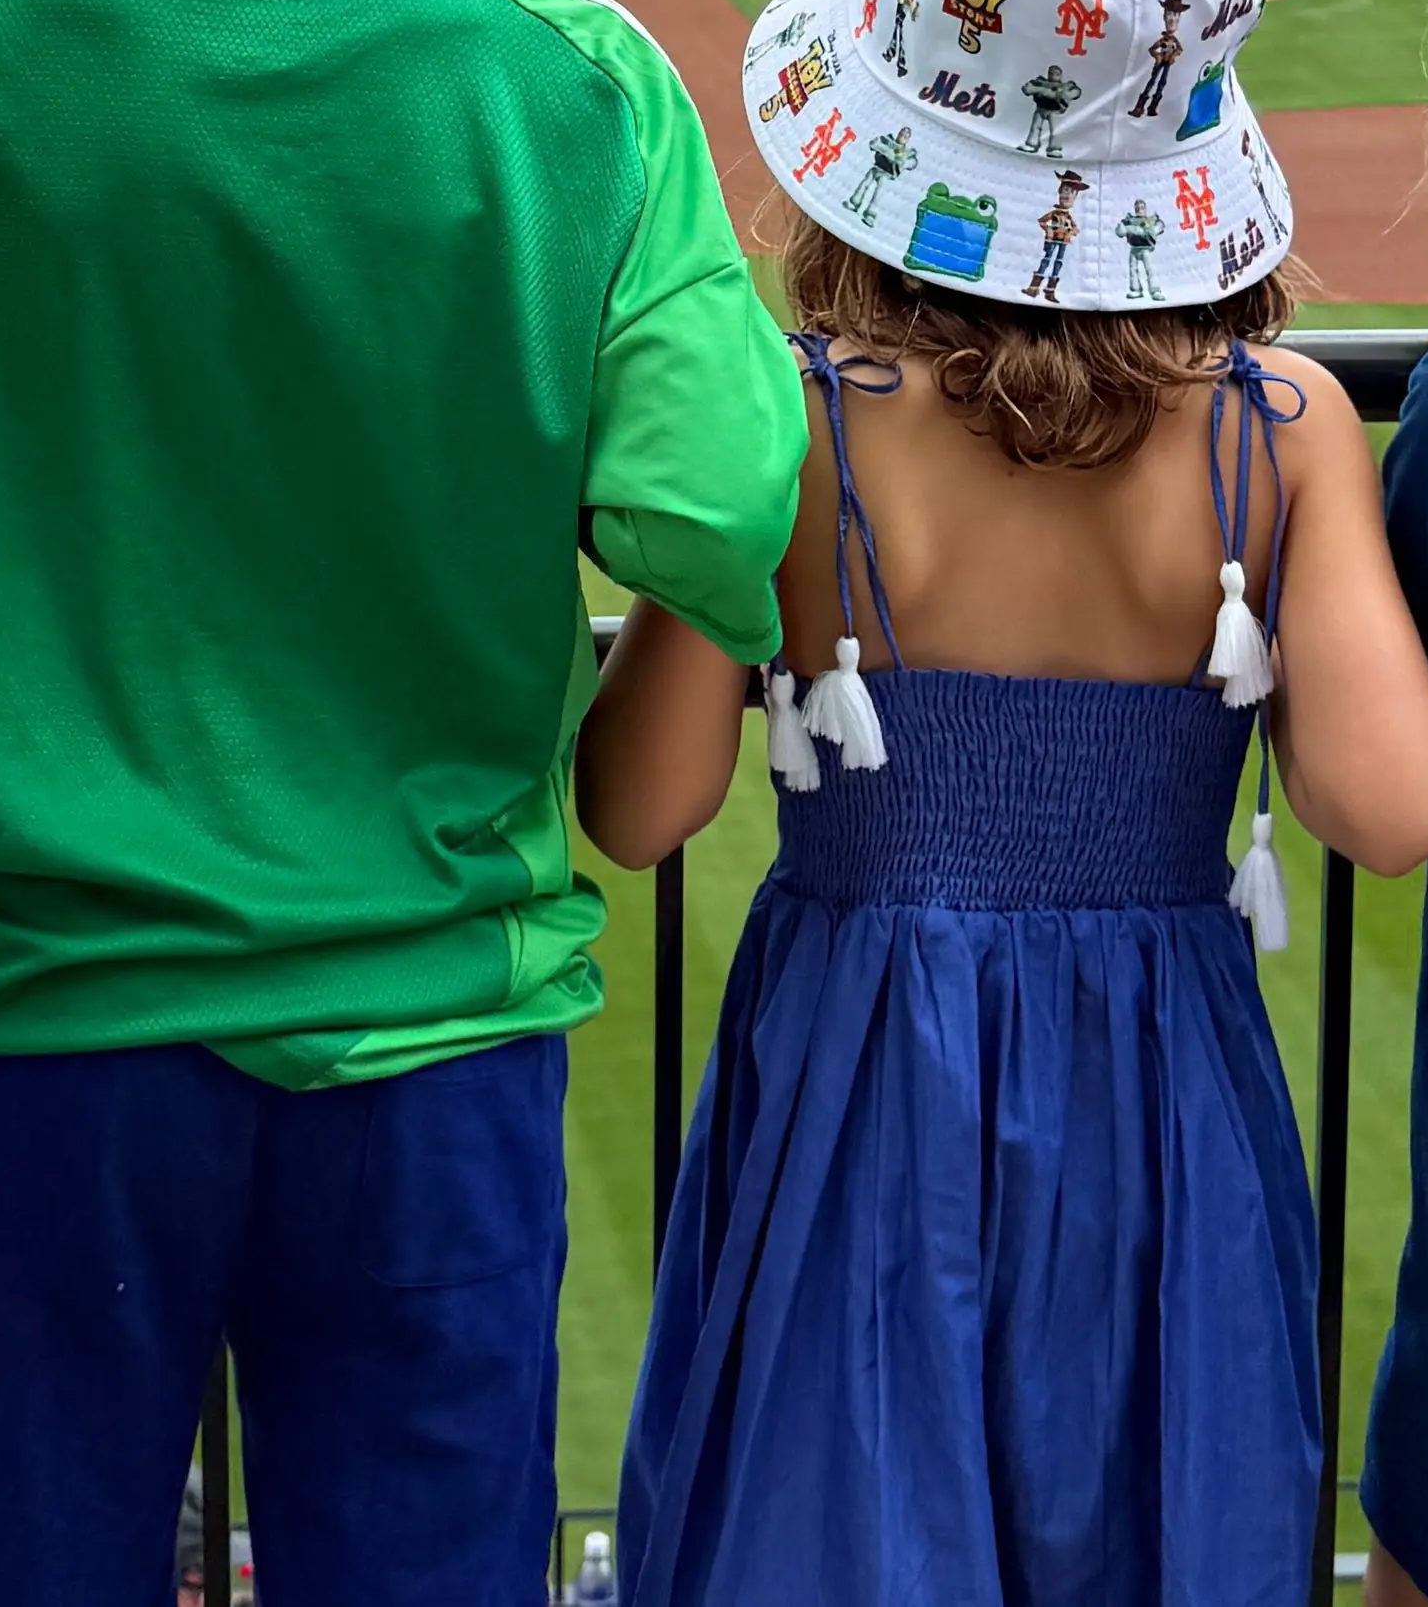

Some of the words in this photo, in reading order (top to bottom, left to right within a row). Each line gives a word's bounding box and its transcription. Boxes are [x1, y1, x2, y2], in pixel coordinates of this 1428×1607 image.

[958, 18, 982, 55] 5
[797, 35, 835, 94] TOY
[759, 87, 789, 123] 5
[918, 70, 997, 119] Mets
[1218, 216, 1266, 291] Mets
